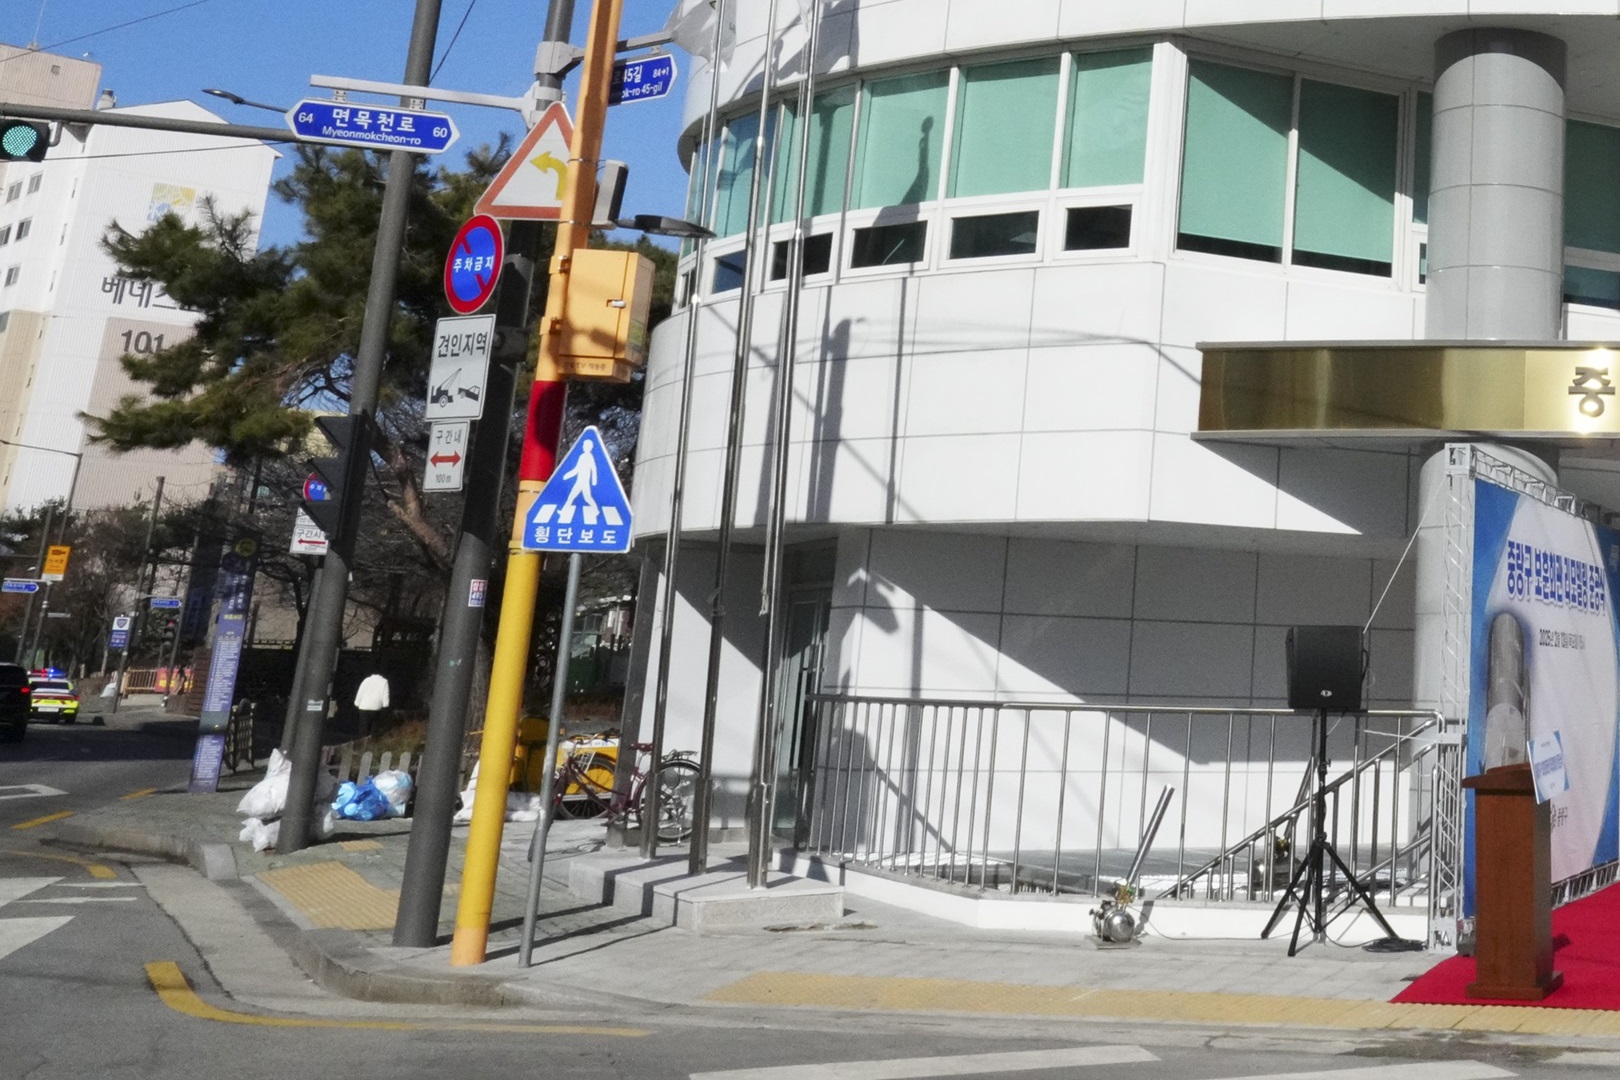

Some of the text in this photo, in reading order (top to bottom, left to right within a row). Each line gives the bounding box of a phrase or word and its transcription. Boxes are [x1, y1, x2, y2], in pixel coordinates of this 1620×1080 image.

[298, 112, 314, 124] 64
[332, 108, 416, 133] 면목천로
[321, 125, 422, 146] Myeonmokcheon-ro
[432, 127, 449, 138] 60
[453, 255, 495, 273] 주차금지
[437, 331, 488, 358] 견인지역
[436, 428, 463, 445] 구간내
[534, 525, 618, 545] 횡단보도
[1507, 540, 1532, 598] 중랑구
[1534, 548, 1563, 603] 보훈회관
